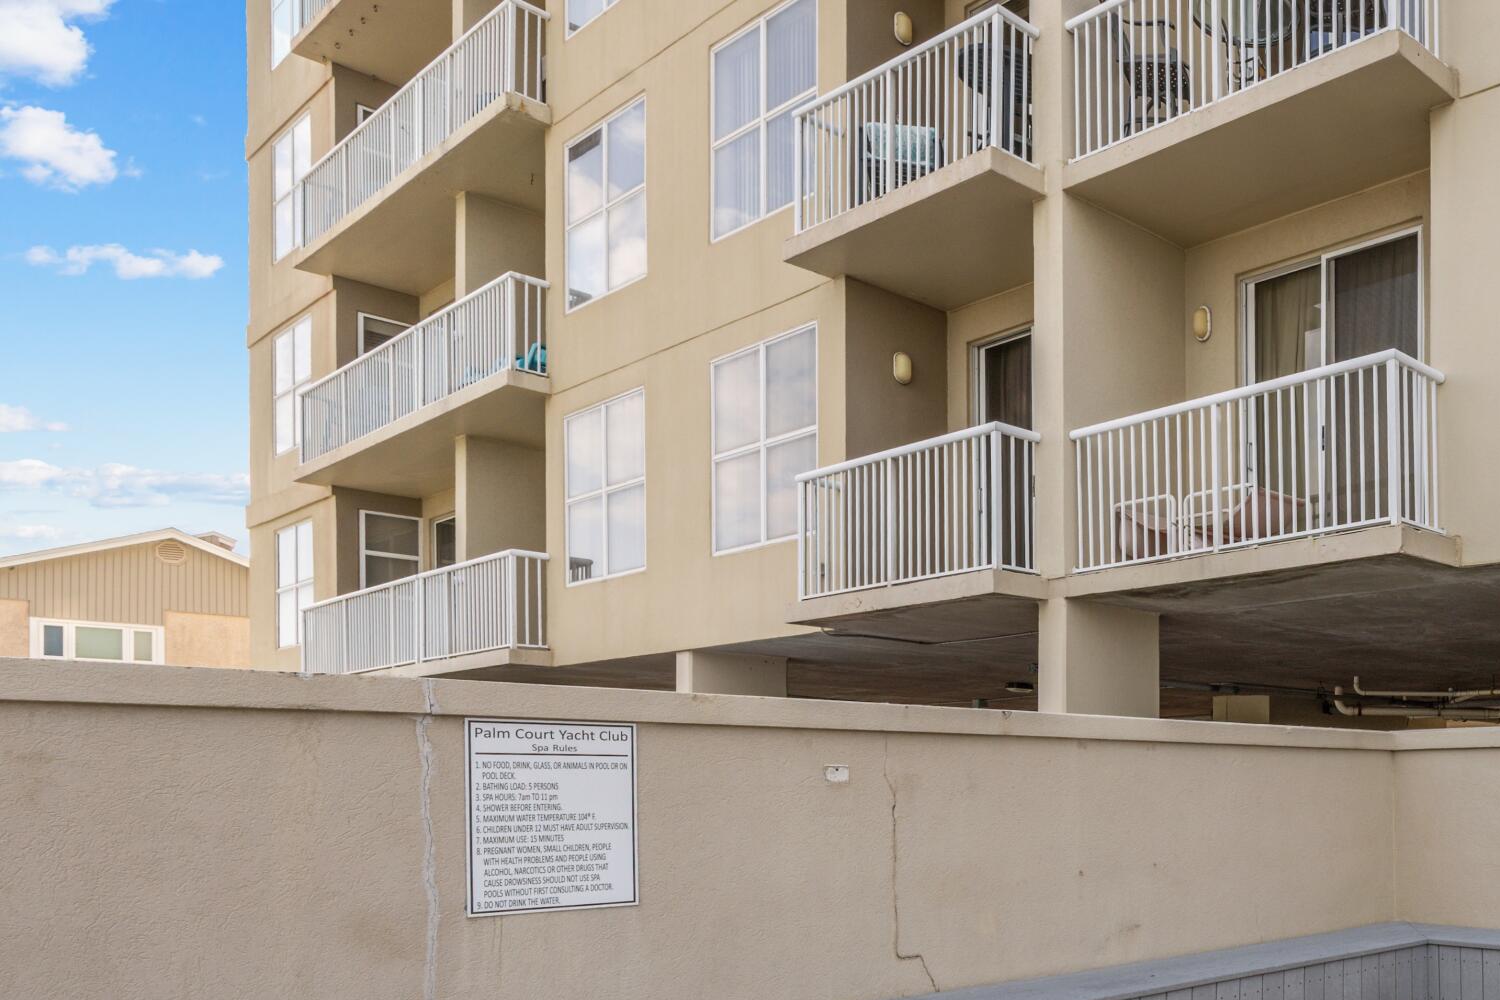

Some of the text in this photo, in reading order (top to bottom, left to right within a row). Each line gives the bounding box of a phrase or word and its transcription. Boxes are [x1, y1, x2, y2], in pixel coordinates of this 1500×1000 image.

[475, 728, 628, 741] Palm Court Yacht Club
[532, 744, 549, 752] Spa
[493, 761, 511, 770] FOOD,
[513, 761, 531, 770] DRINK,
[533, 762, 552, 770] GLASS,
[536, 813, 576, 821] TEMPERATURE
[483, 825, 512, 833] CHILDREN
[543, 824, 559, 832] MUST
[484, 847, 515, 855] PREGNANT
[516, 846, 542, 854] WOMEN,
[544, 845, 560, 853] SMALL
[484, 858, 499, 866] WITH
[524, 856, 553, 864] PROBLEMS
[514, 866, 546, 874] NARCOTICS
[484, 879, 502, 887] CAUSE
[504, 878, 542, 886] DROWSINESS
[543, 876, 565, 884] SHOULD
[484, 890, 503, 898] POOLS
[504, 888, 532, 896] WITHOUT
[550, 885, 584, 894] CONSULTING
[495, 900, 507, 908] NOT
[509, 899, 526, 907] DRINK
